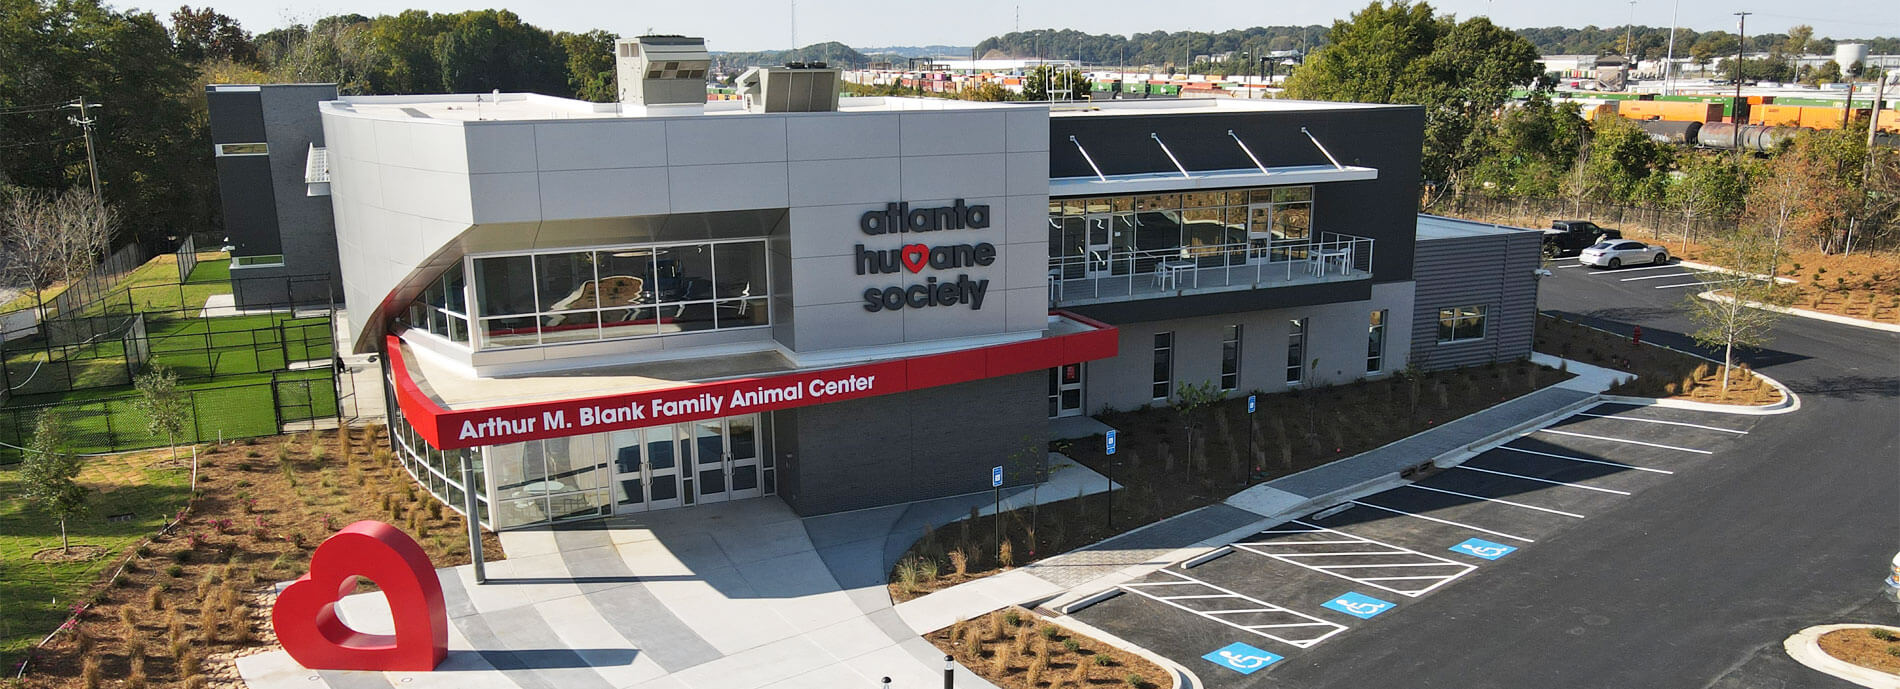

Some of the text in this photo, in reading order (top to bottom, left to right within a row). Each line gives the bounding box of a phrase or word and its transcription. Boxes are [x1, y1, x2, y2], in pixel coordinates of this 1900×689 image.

[861, 199, 990, 235] atlanta
[855, 243, 996, 275] huane
[863, 274, 989, 312] society
[459, 375, 875, 440] Arthur M. Blank Family Animal Center
